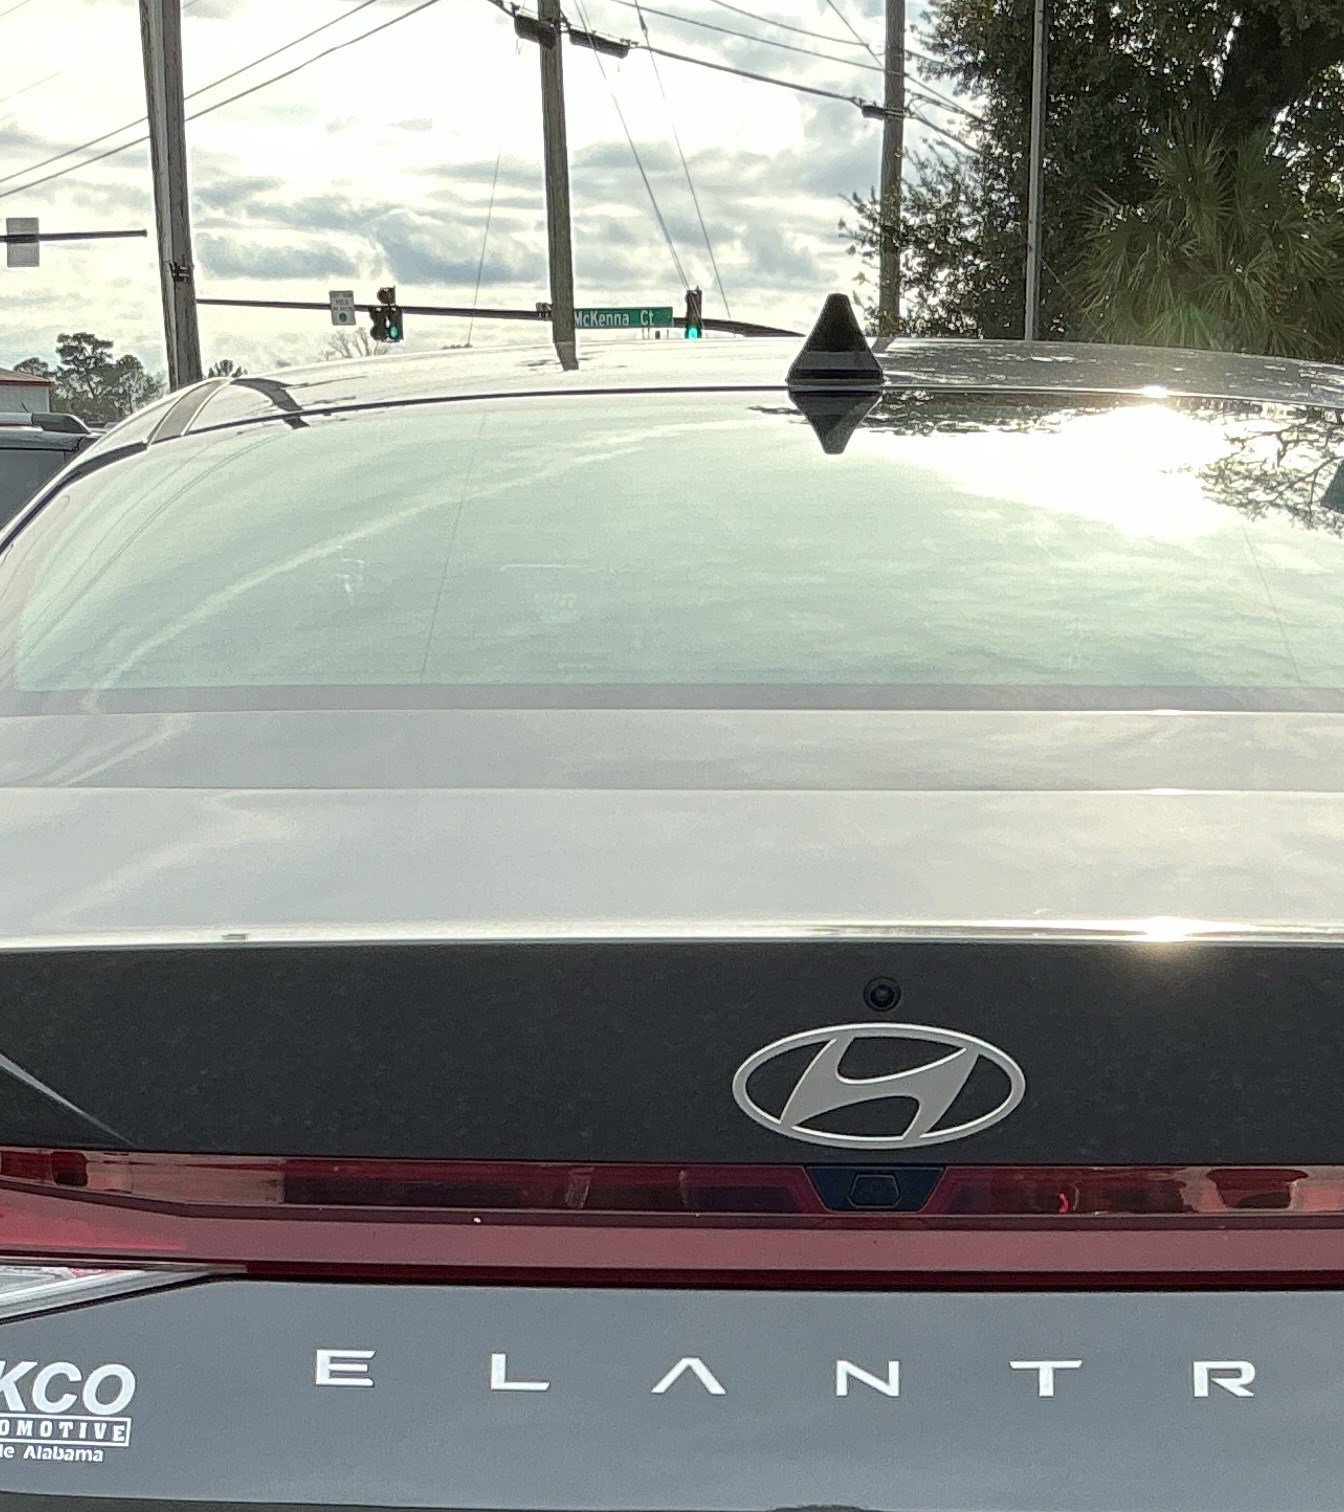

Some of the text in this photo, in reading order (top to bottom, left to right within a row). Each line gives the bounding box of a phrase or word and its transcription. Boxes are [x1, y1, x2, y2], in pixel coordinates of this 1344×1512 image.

[574, 309, 654, 327] McKenna Ct
[23, 1445, 104, 1462] Alabama
